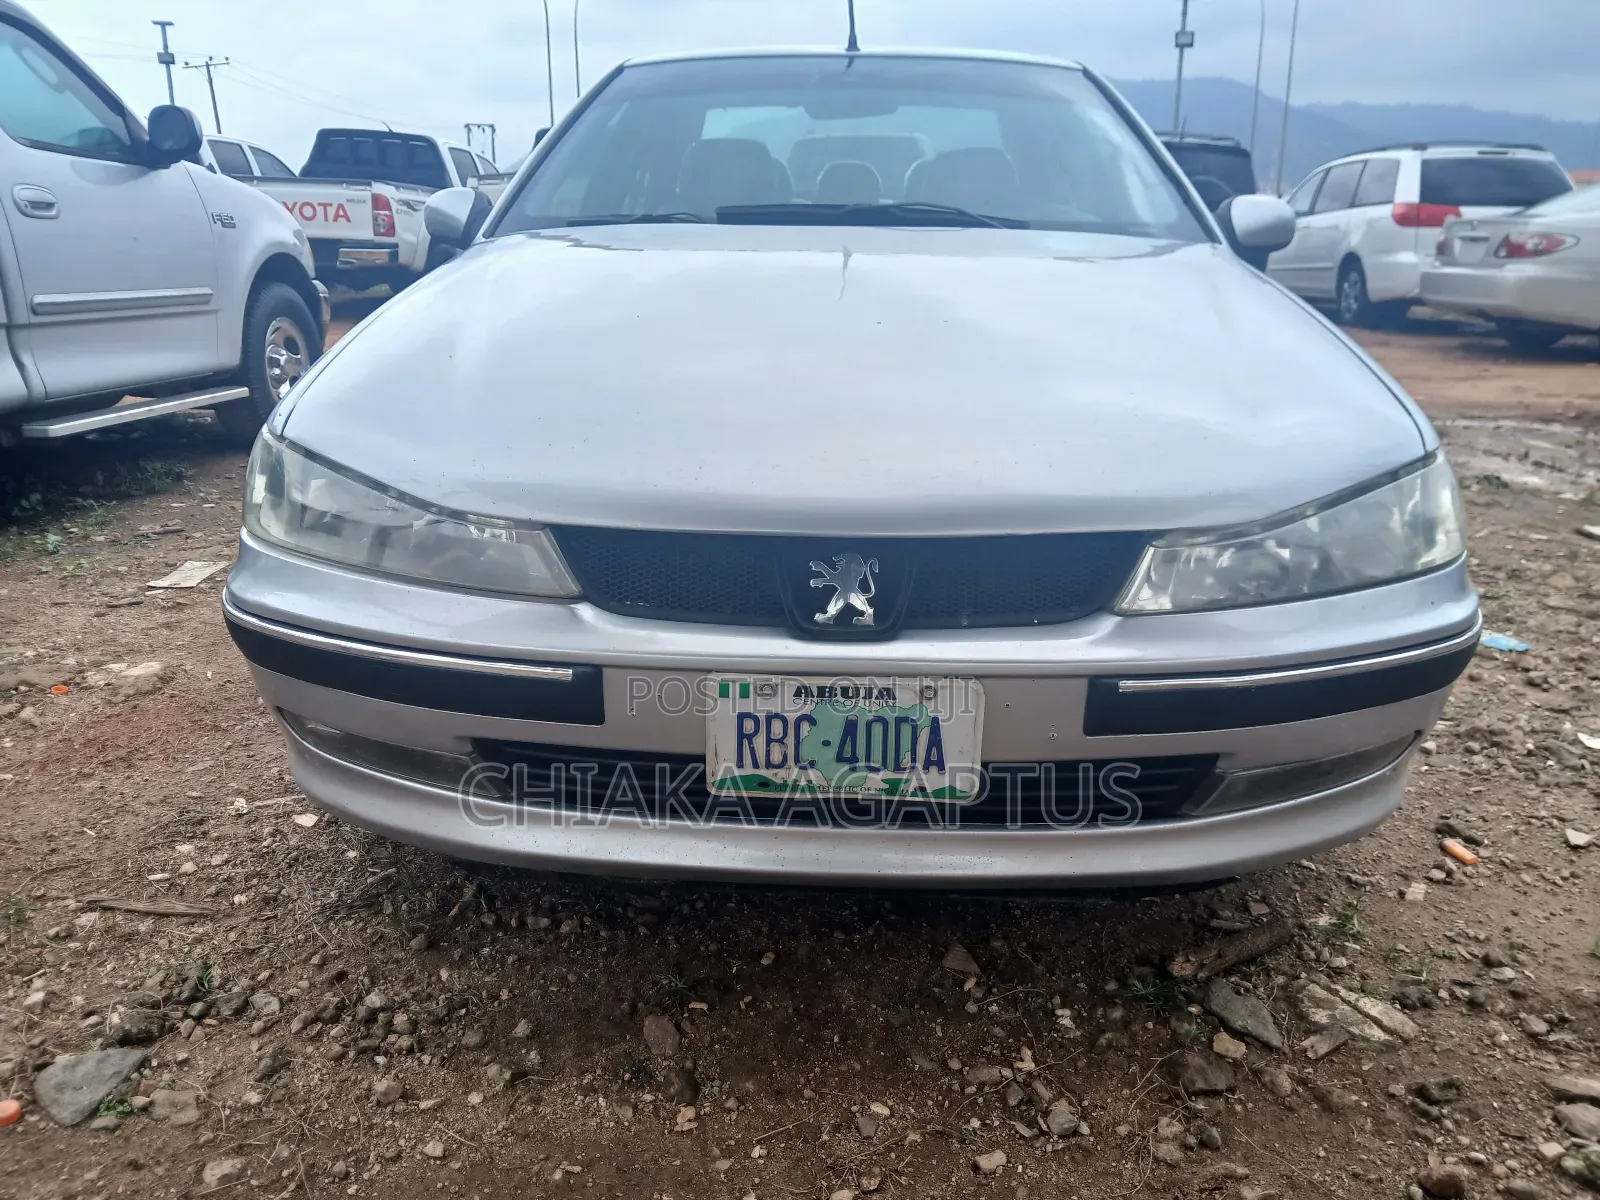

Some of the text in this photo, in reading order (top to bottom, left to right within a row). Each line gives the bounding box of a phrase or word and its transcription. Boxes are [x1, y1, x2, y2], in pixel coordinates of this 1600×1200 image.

[281, 201, 352, 223] YOTA
[792, 685, 897, 701] ABUJA
[792, 698, 897, 708] CENTRE OF UNITY
